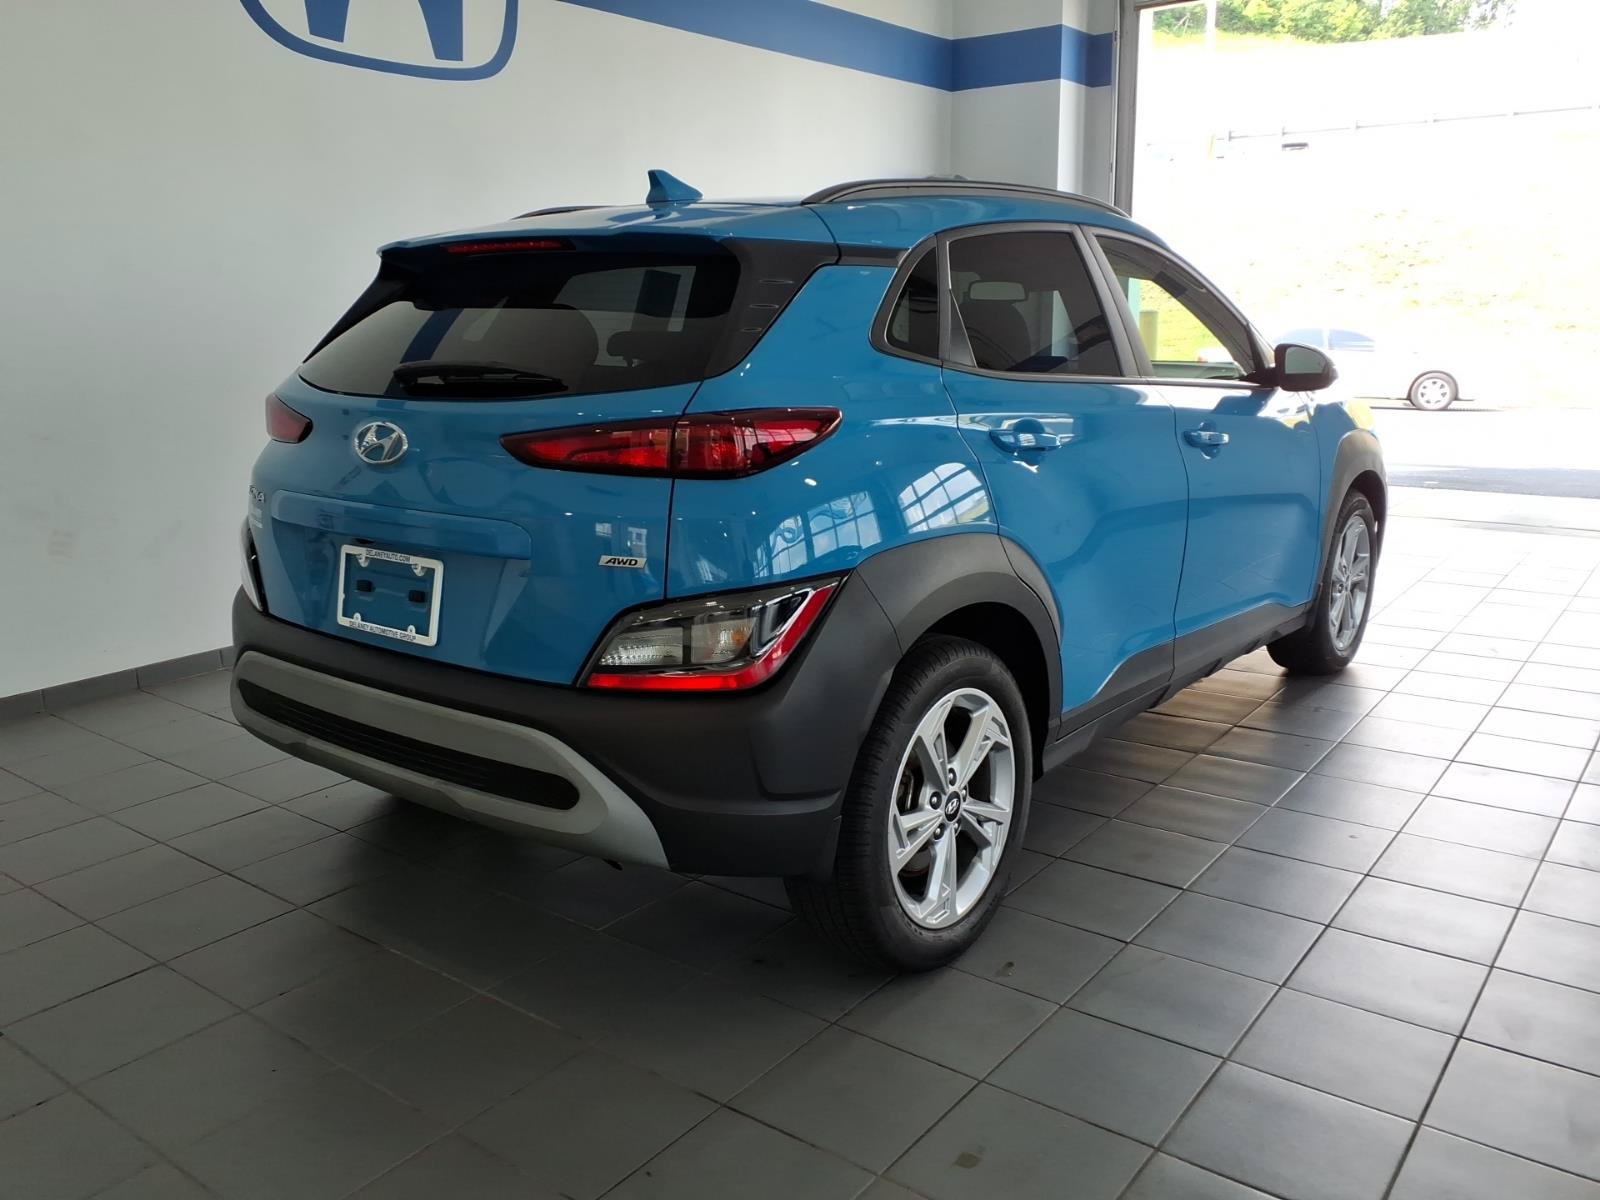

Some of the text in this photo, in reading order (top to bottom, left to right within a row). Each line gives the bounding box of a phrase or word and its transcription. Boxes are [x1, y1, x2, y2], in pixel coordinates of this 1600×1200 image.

[366, 549, 411, 562] DELANEYAUTO.COM
[605, 557, 638, 566] AWD
[349, 620, 417, 641] DELANEY AUTOMOTIVE GROUP
